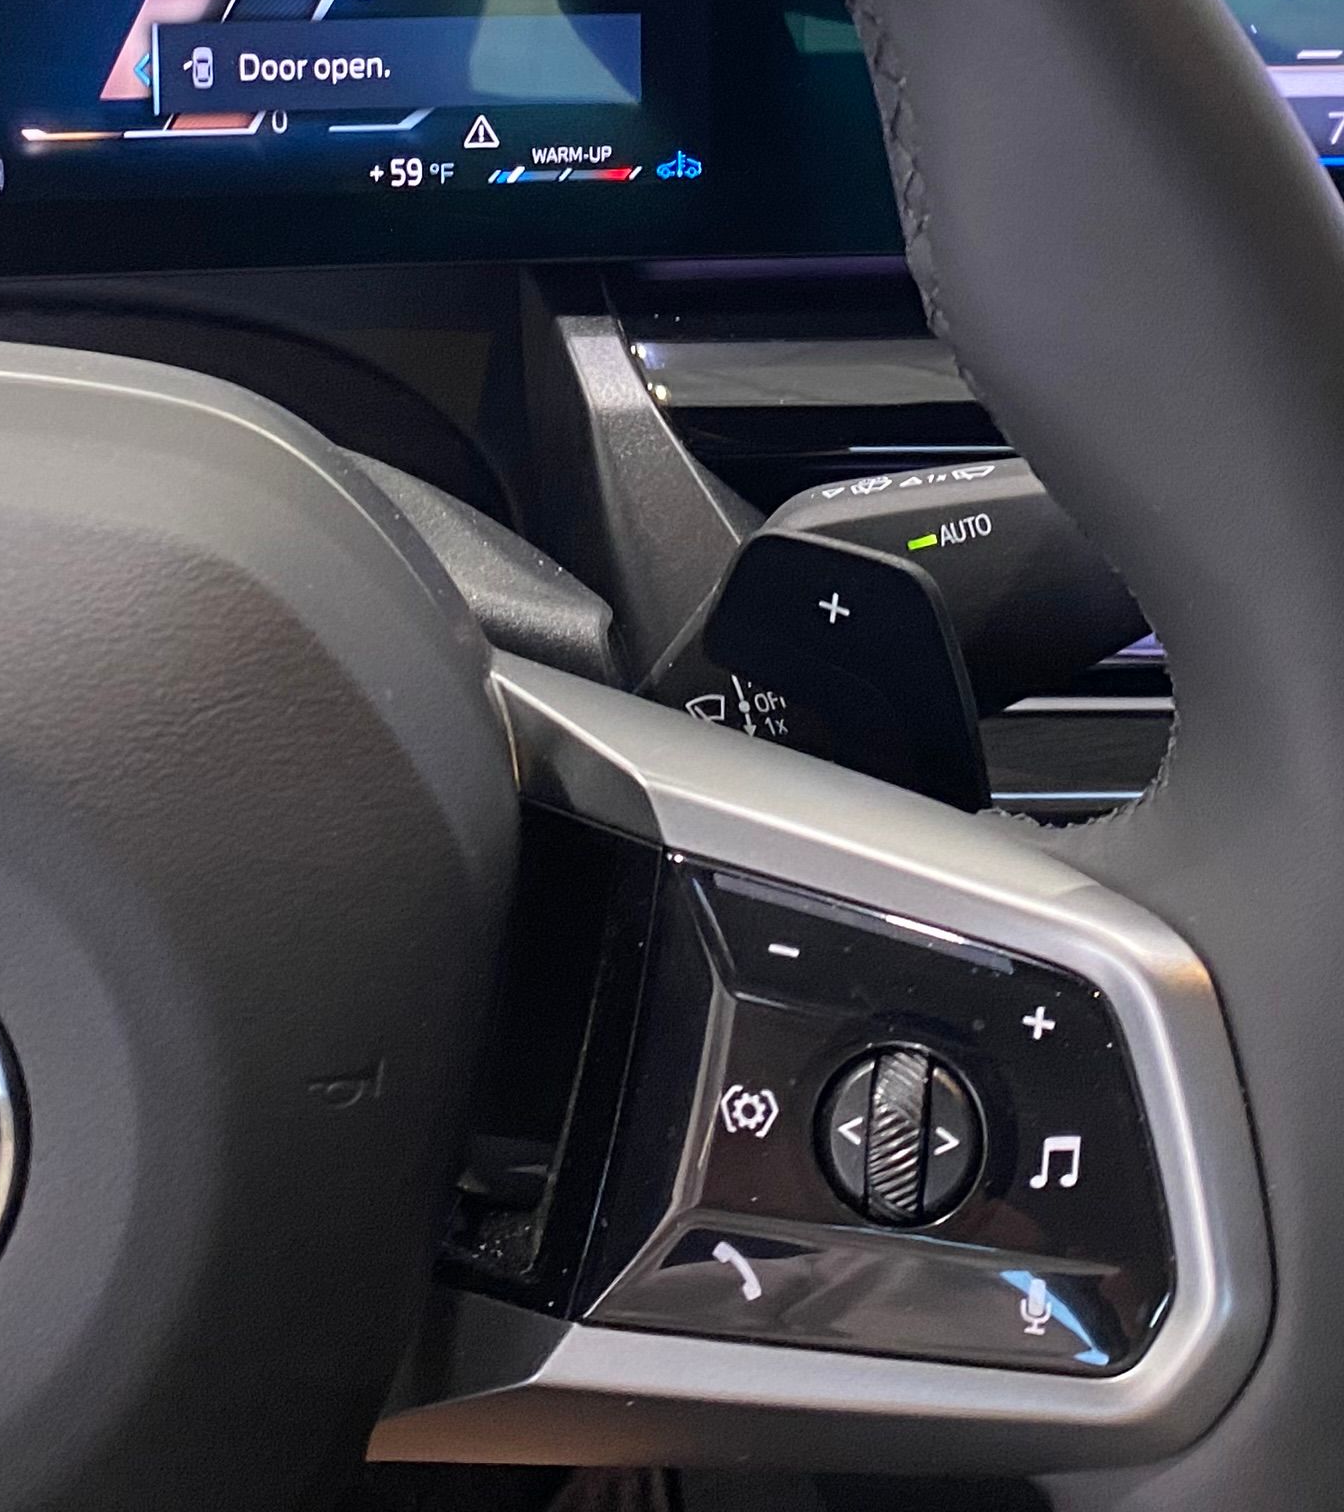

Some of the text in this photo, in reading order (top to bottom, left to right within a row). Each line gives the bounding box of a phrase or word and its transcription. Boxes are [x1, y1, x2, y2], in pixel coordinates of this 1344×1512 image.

[239, 53, 391, 84] Door open.
[272, 110, 288, 133] 0
[532, 146, 612, 165] WARM-UP
[430, 163, 455, 184] °F
[940, 512, 992, 547] AUTO
[764, 716, 789, 737] 1x
